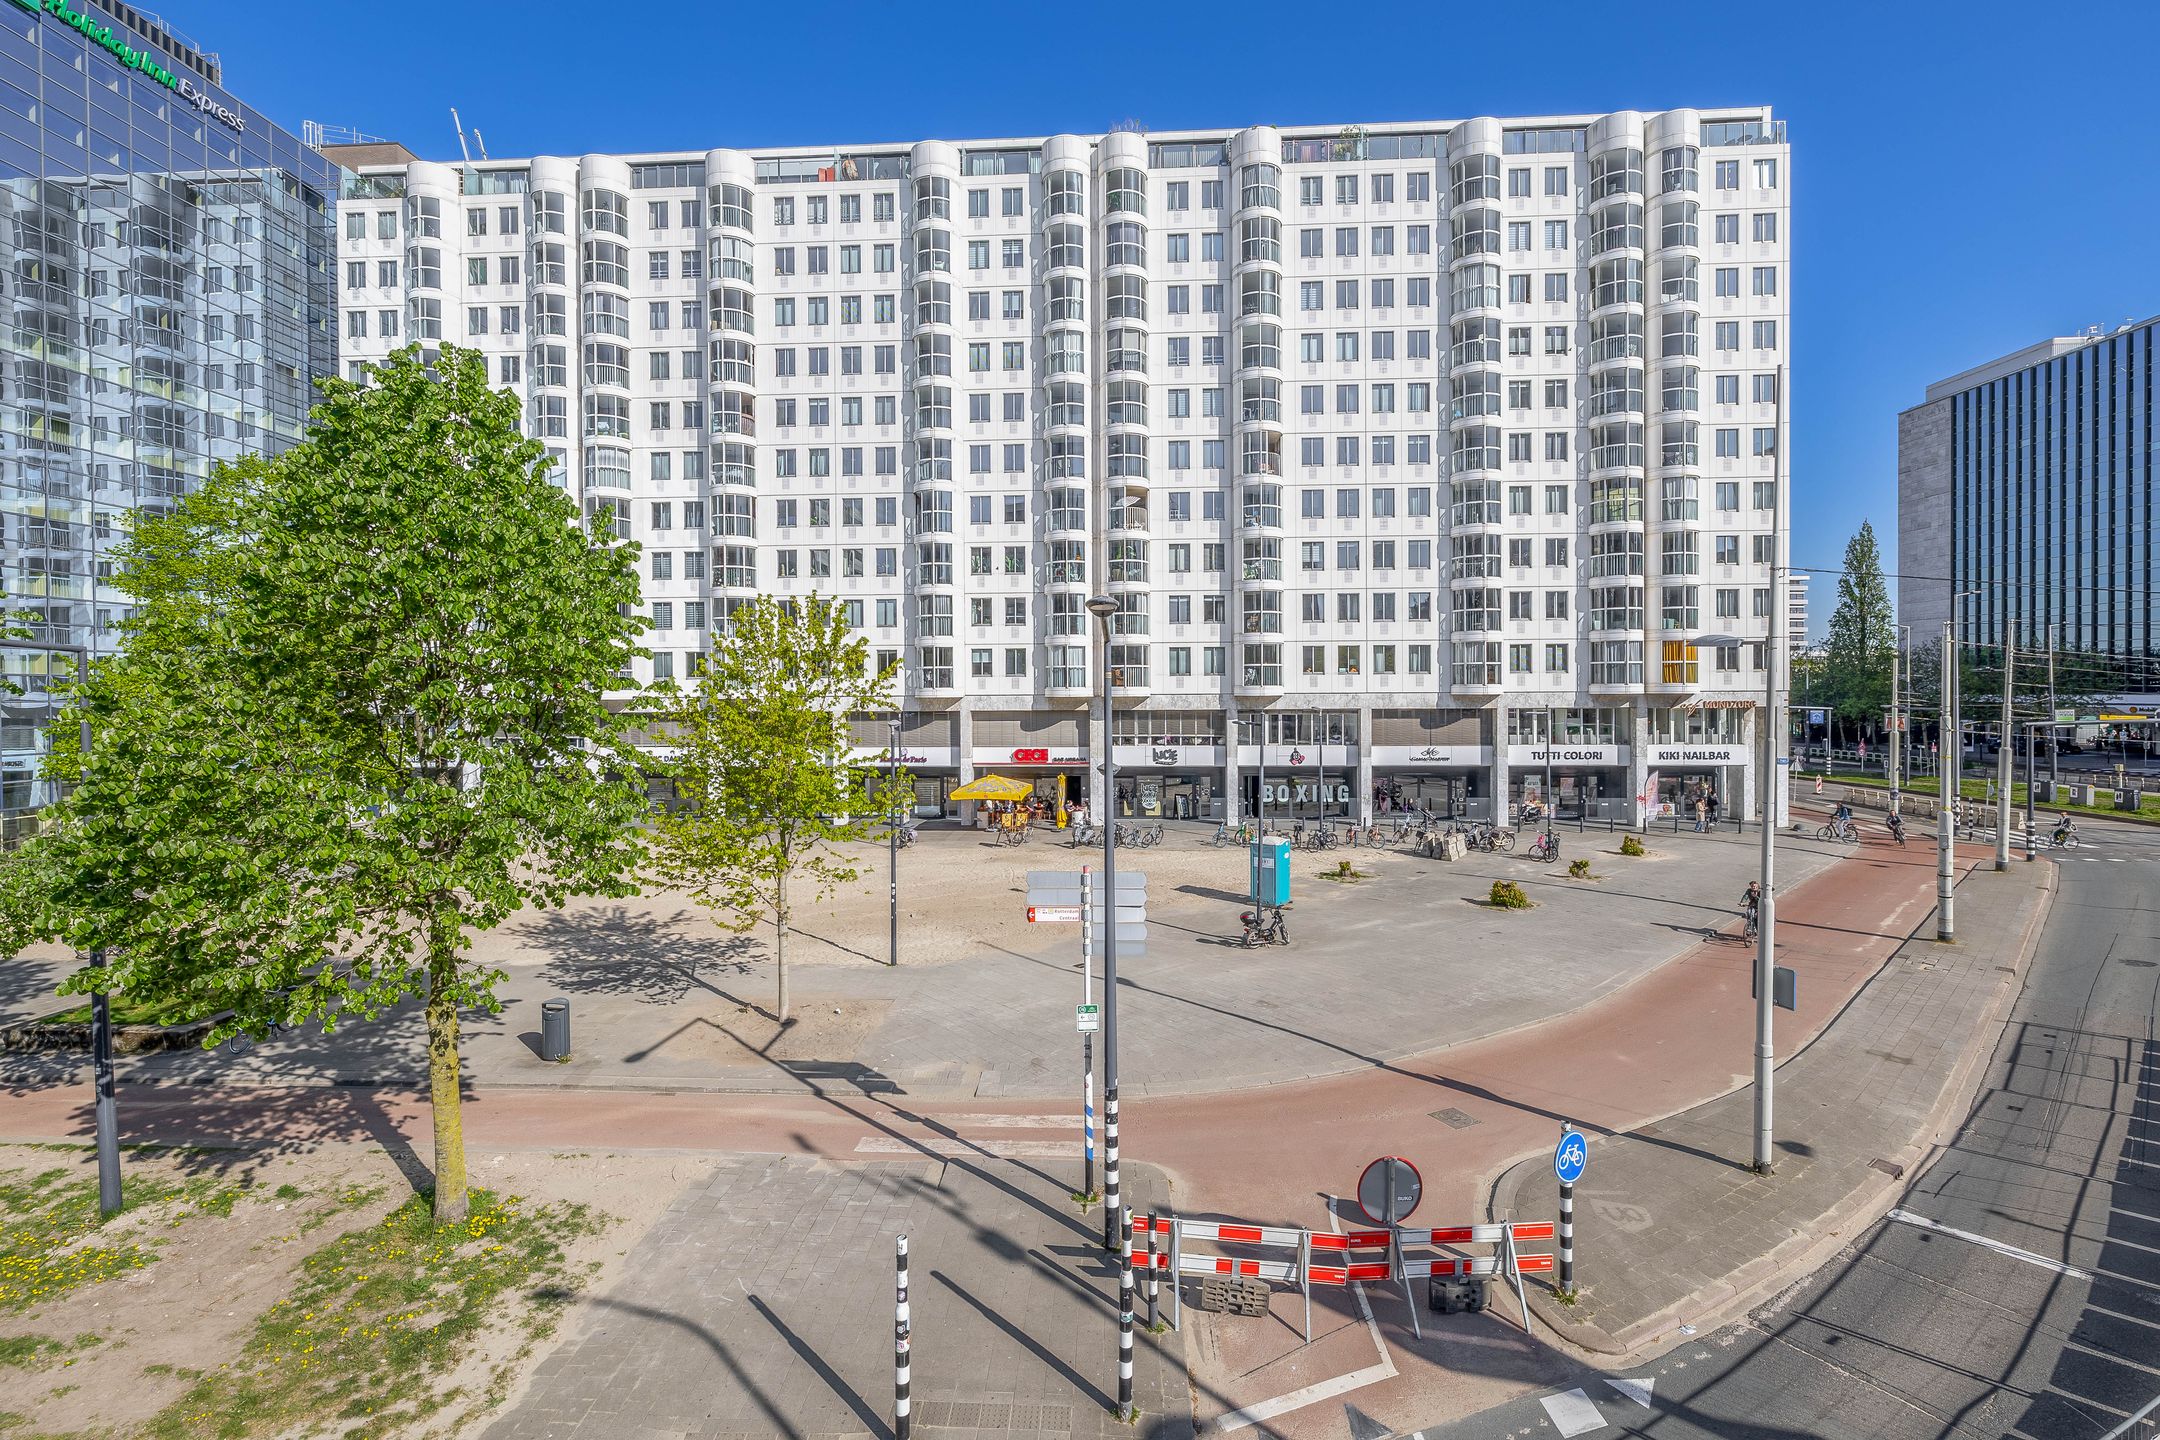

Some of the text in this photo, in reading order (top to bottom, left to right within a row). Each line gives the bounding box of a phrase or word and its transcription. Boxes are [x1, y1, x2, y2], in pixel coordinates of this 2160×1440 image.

[43, 0, 245, 132] Holiday Inn Express
[1564, 751, 1603, 760] COLORI
[1658, 751, 1731, 760] KIKI NAILBAR
[1262, 784, 1350, 803] BOXING
